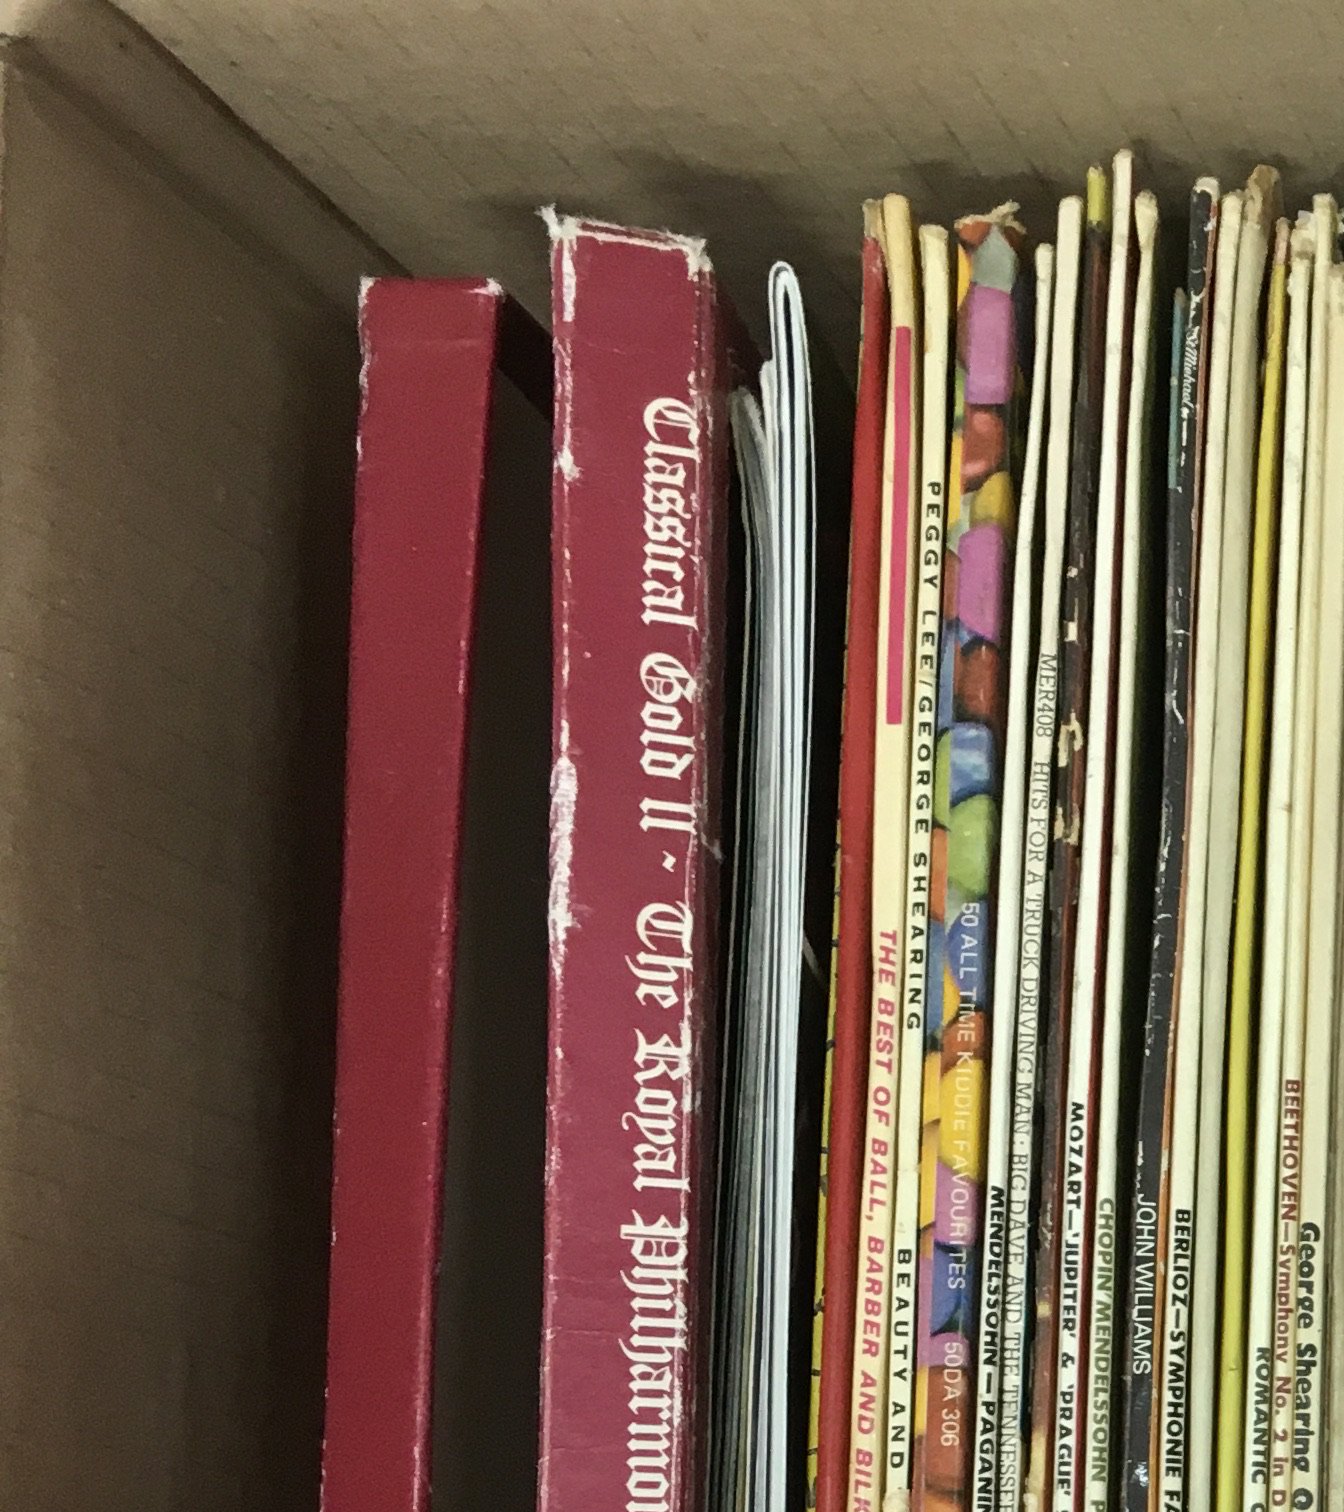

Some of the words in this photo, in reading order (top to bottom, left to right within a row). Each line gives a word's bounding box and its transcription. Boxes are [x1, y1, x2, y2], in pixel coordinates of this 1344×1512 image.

[640, 396, 697, 626] Classical
[922, 482, 942, 588] PEGGY
[640, 652, 693, 780] Gold
[626, 901, 693, 1006] The
[906, 853, 927, 1030] SHEARING
[960, 902, 980, 927] 50
[875, 929, 898, 992] THE
[957, 934, 979, 978] ALL
[873, 1001, 895, 1071] BEST
[955, 1003, 977, 1042] TIME
[623, 1029, 690, 1191] Royal
[872, 1085, 892, 1125] OF
[951, 1050, 975, 1132] KIDDIE
[865, 1137, 890, 1221] BALL,
[946, 1141, 972, 1290] FAVOURITES
[860, 1236, 885, 1358] BARBER
[856, 1370, 880, 1434] AND
[940, 1342, 964, 1401] 50DA
[939, 1408, 960, 1446] 306
